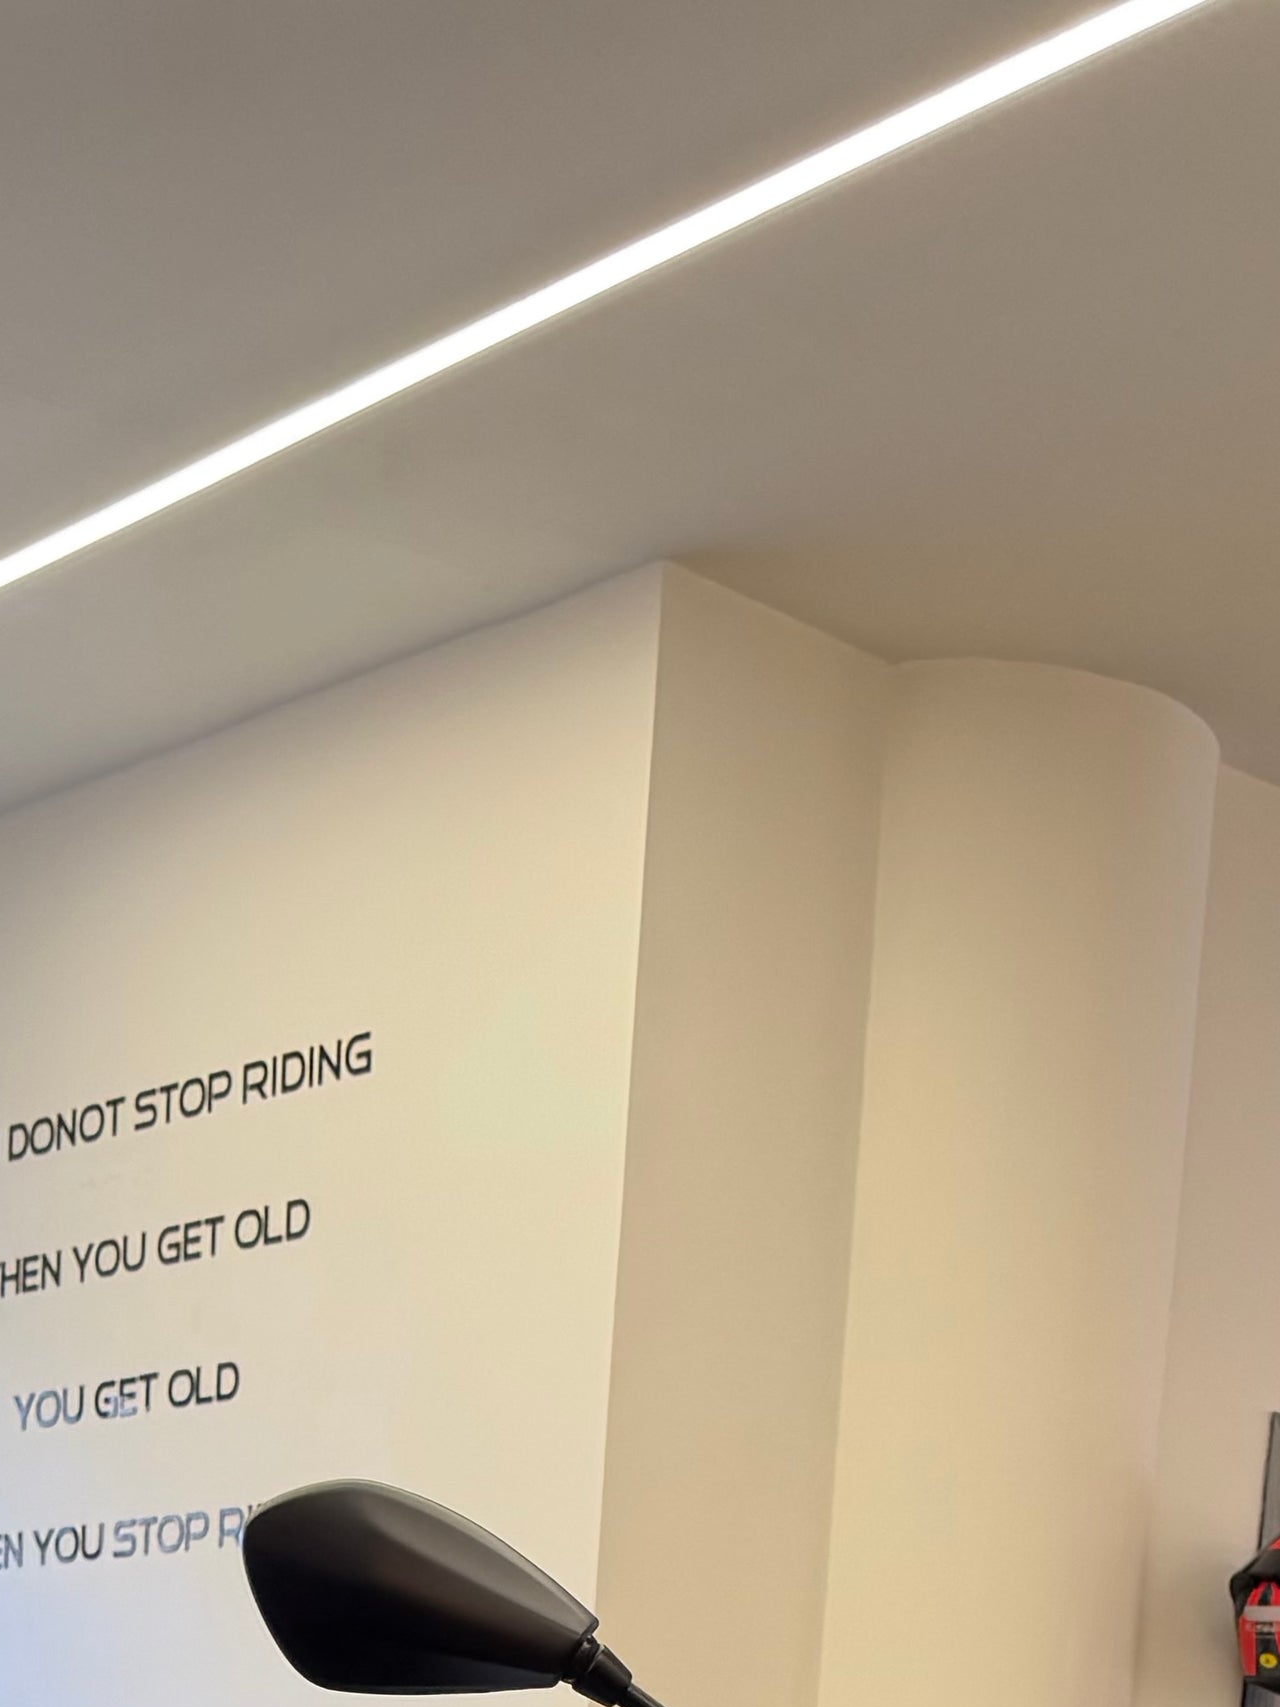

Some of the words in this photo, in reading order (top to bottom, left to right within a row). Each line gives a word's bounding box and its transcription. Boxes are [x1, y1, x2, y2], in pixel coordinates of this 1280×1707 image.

[7, 1097, 124, 1162] DONOT
[134, 1070, 232, 1132] STOP
[241, 1031, 373, 1105] RIDING
[73, 1232, 148, 1283] YOU
[157, 1216, 225, 1266] GET
[234, 1198, 311, 1250] OLD
[13, 1388, 84, 1432] YOU
[93, 1372, 159, 1420] GET
[167, 1361, 240, 1409] OLD
[32, 1525, 105, 1564] YOU
[112, 1512, 209, 1560] STOP
